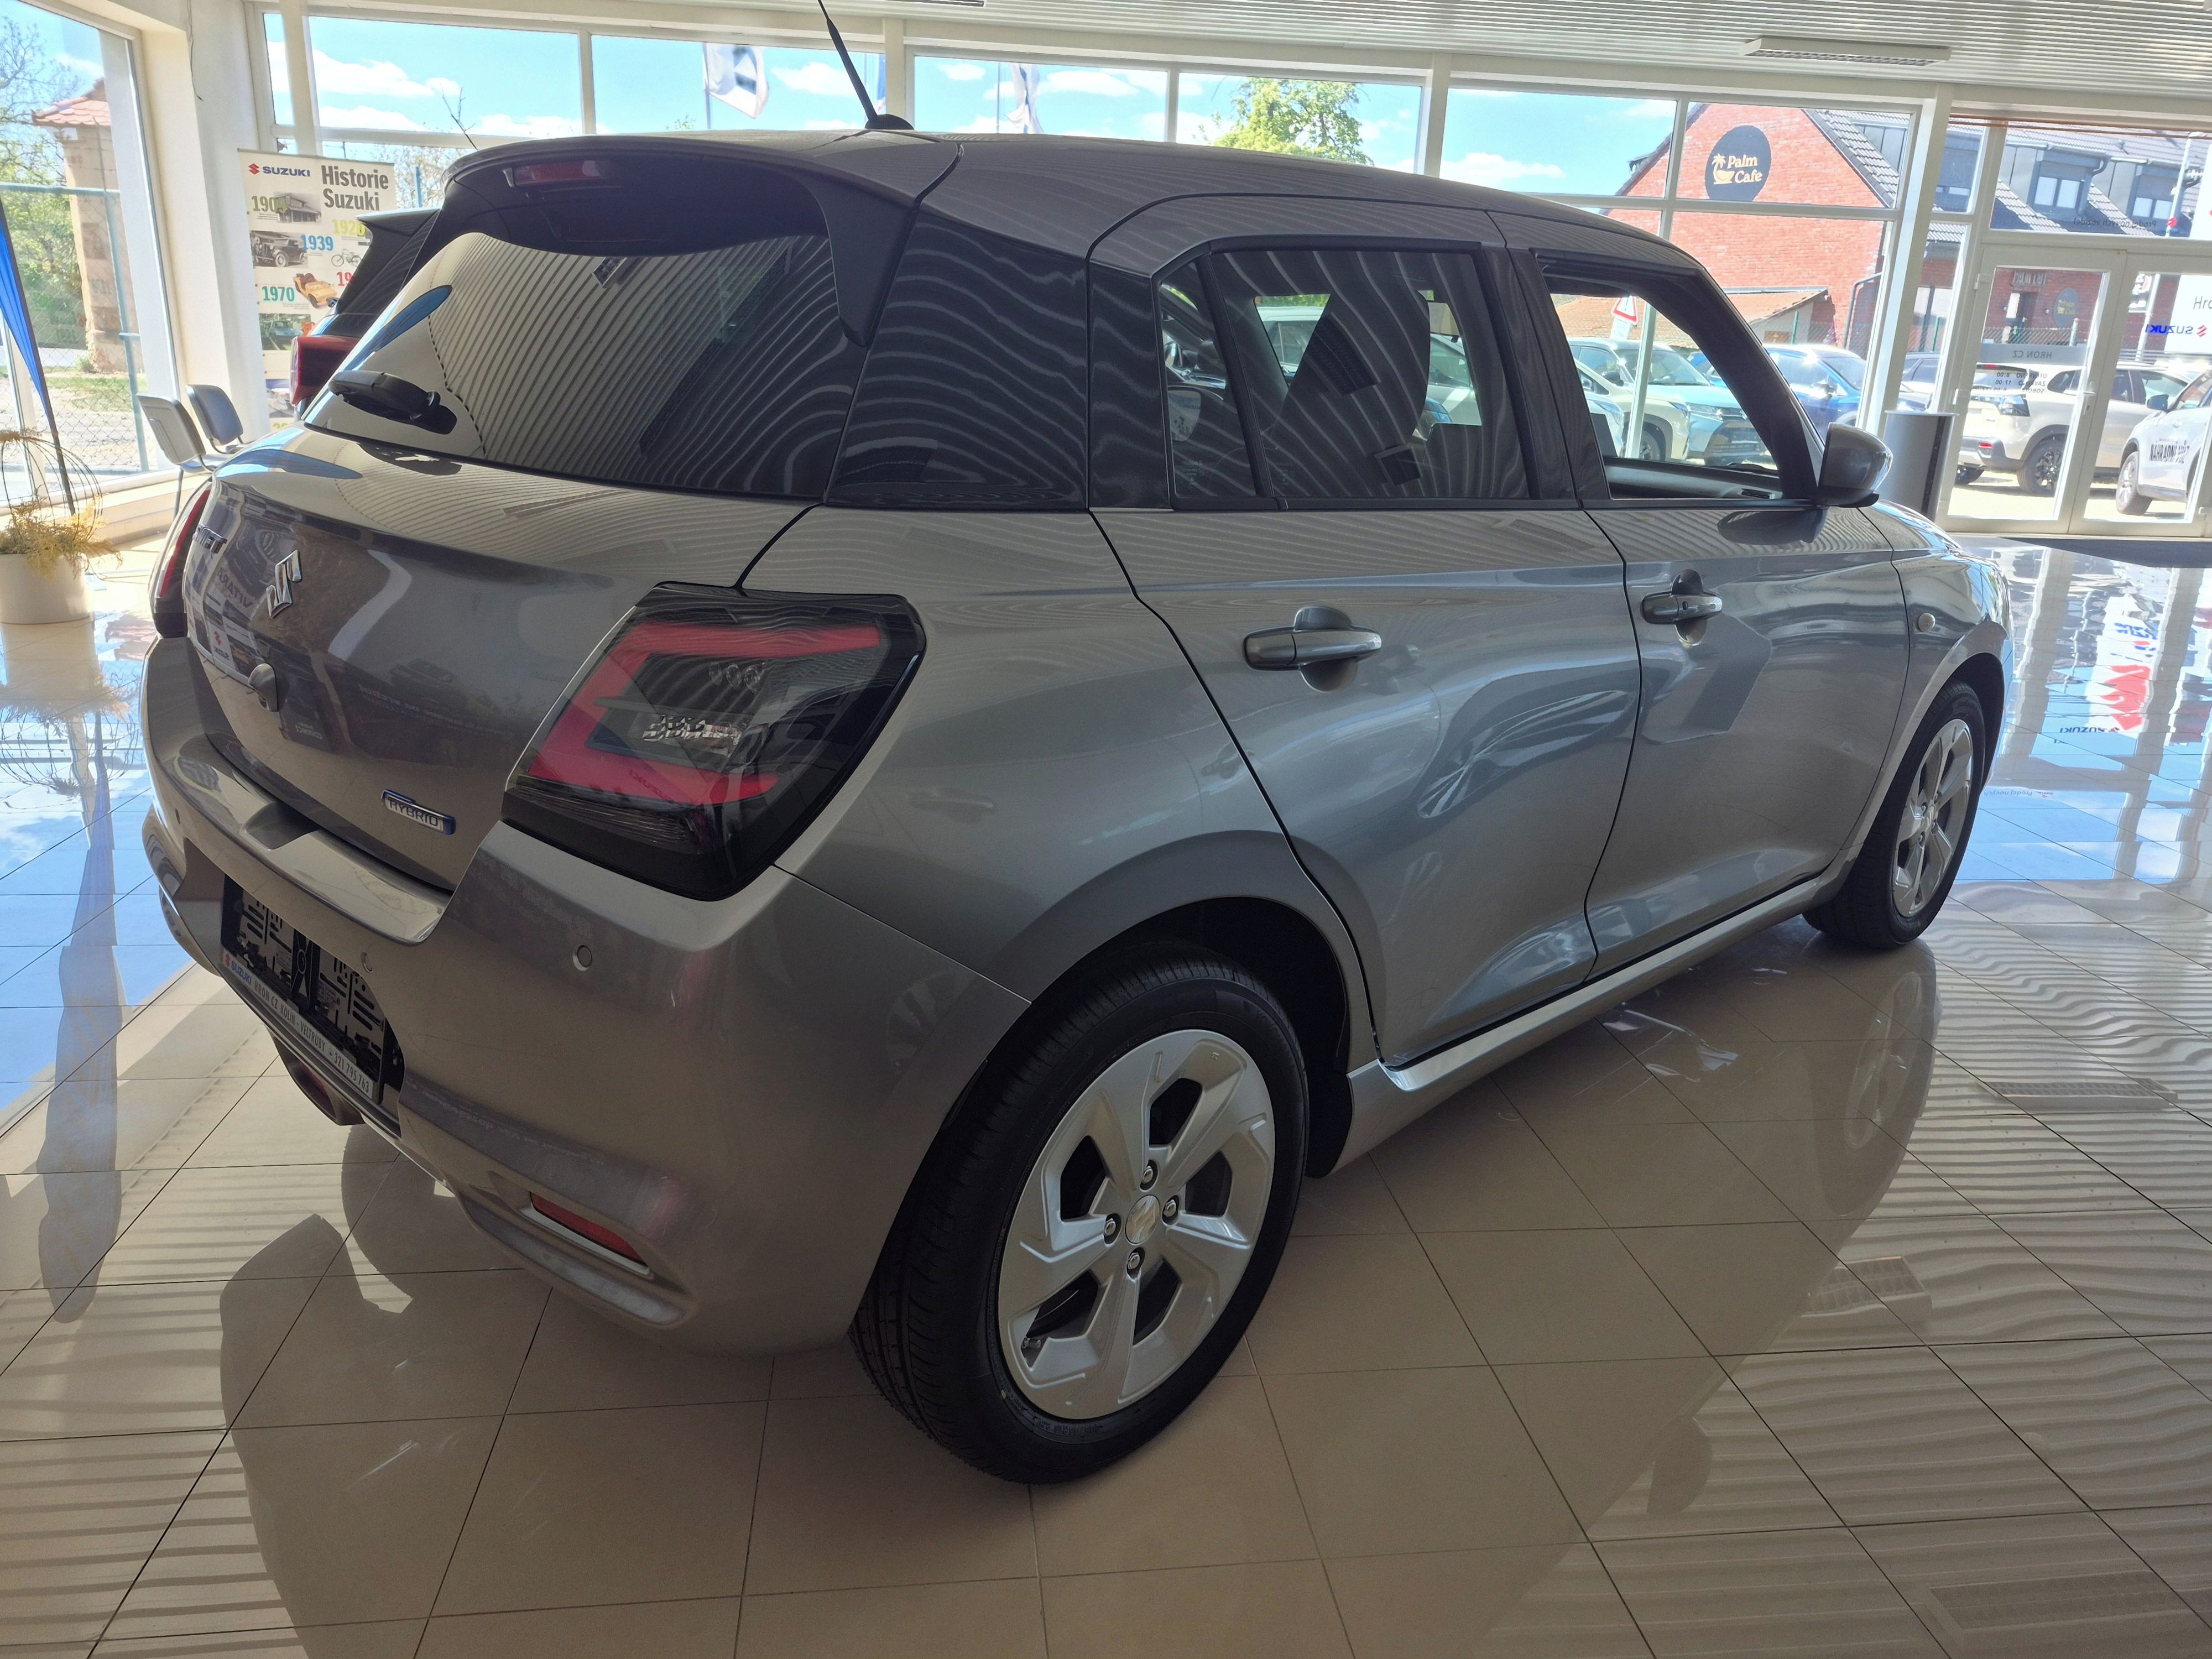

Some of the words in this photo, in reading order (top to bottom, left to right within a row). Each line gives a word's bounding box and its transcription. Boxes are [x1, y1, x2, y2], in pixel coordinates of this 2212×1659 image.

[1727, 154, 1758, 169] Palm
[263, 166, 310, 177] SUZUKI
[321, 165, 389, 190] Historie
[1734, 169, 1762, 184] Cafe
[323, 188, 380, 211] Suzuki
[301, 234, 333, 251] 1939
[337, 272, 354, 286] 19
[262, 286, 295, 301] 1970
[387, 796, 438, 827] HYBRID
[231, 961, 252, 984] SUZUKI
[254, 980, 270, 1002] HRON
[271, 995, 278, 1010] CZ
[280, 1004, 296, 1025] KOLÍN
[300, 1021, 326, 1051] VELTRUBY
[334, 1052, 344, 1070] 321
[347, 1062, 357, 1081] 795
[359, 1074, 369, 1093] 763
